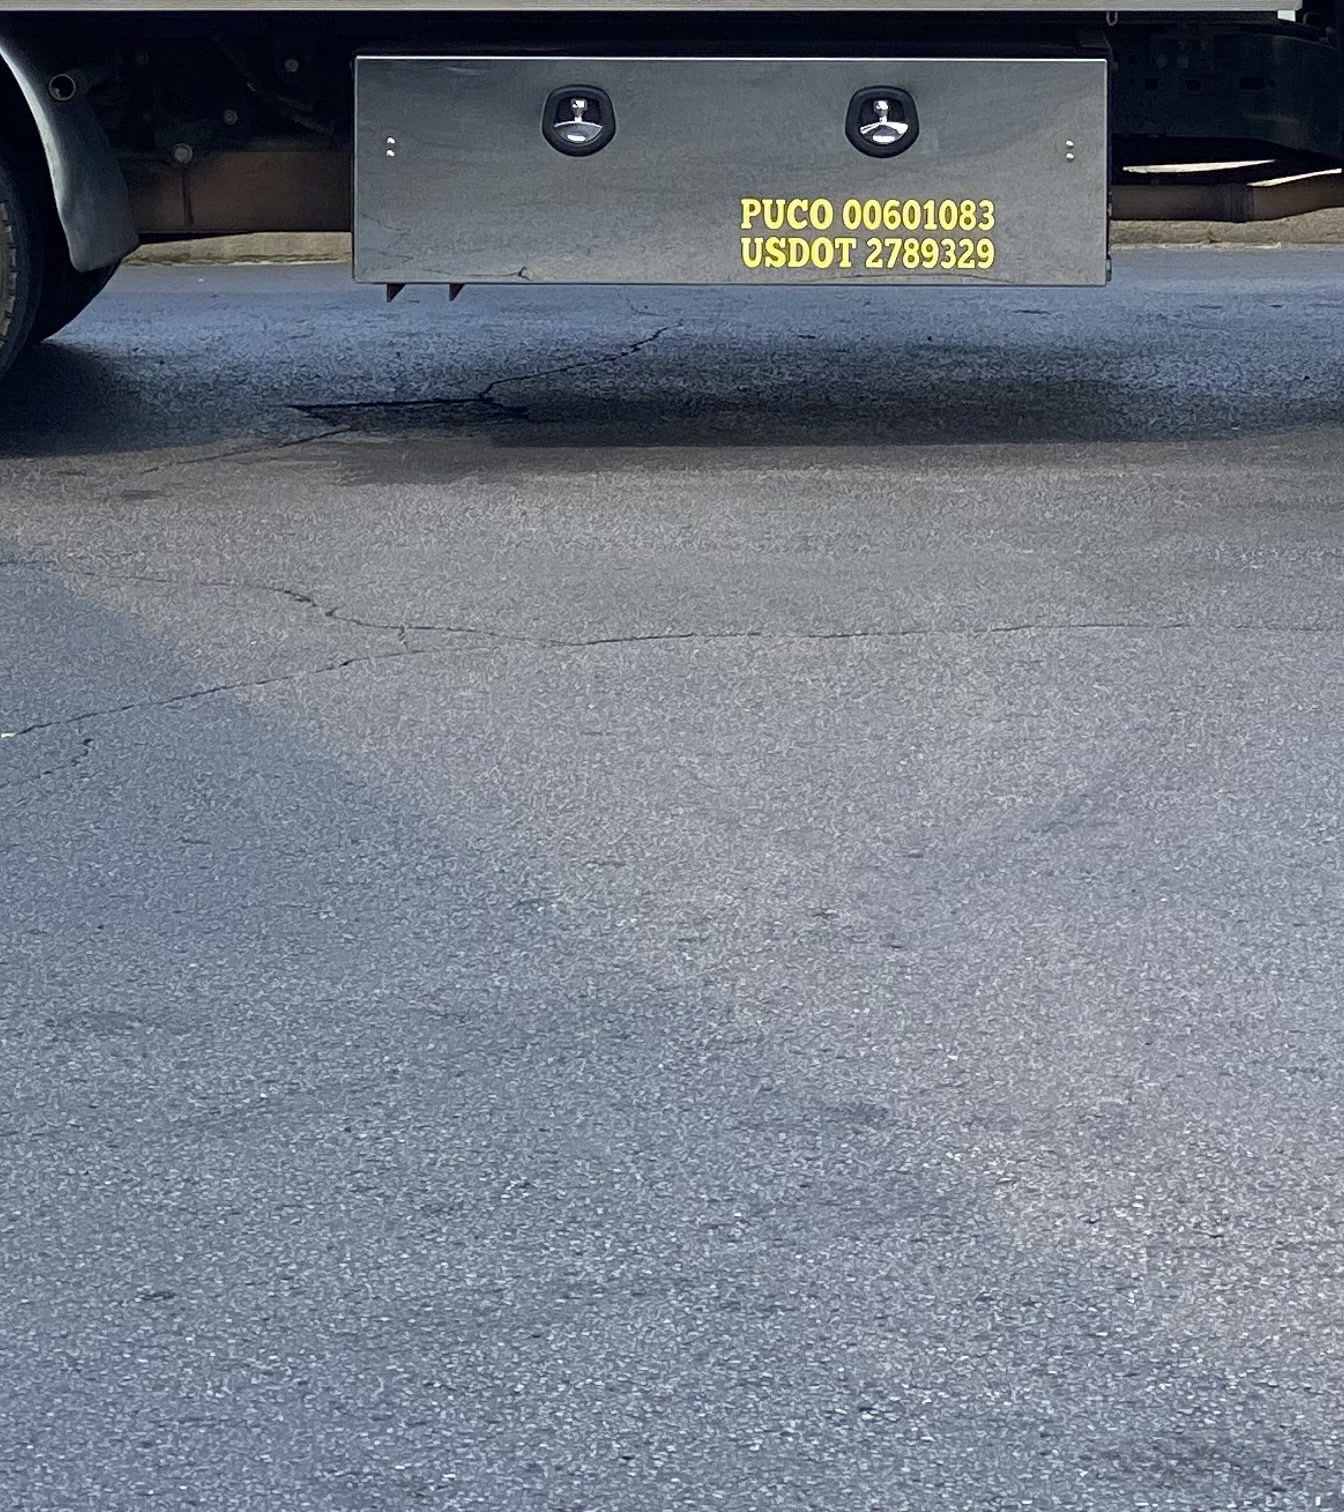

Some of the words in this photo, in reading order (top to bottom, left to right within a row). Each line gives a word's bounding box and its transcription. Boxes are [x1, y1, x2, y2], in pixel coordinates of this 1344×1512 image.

[741, 199, 833, 230] PUCO
[843, 199, 995, 231] 00601083
[741, 237, 856, 269] USDOT
[865, 237, 995, 269] 2789329
